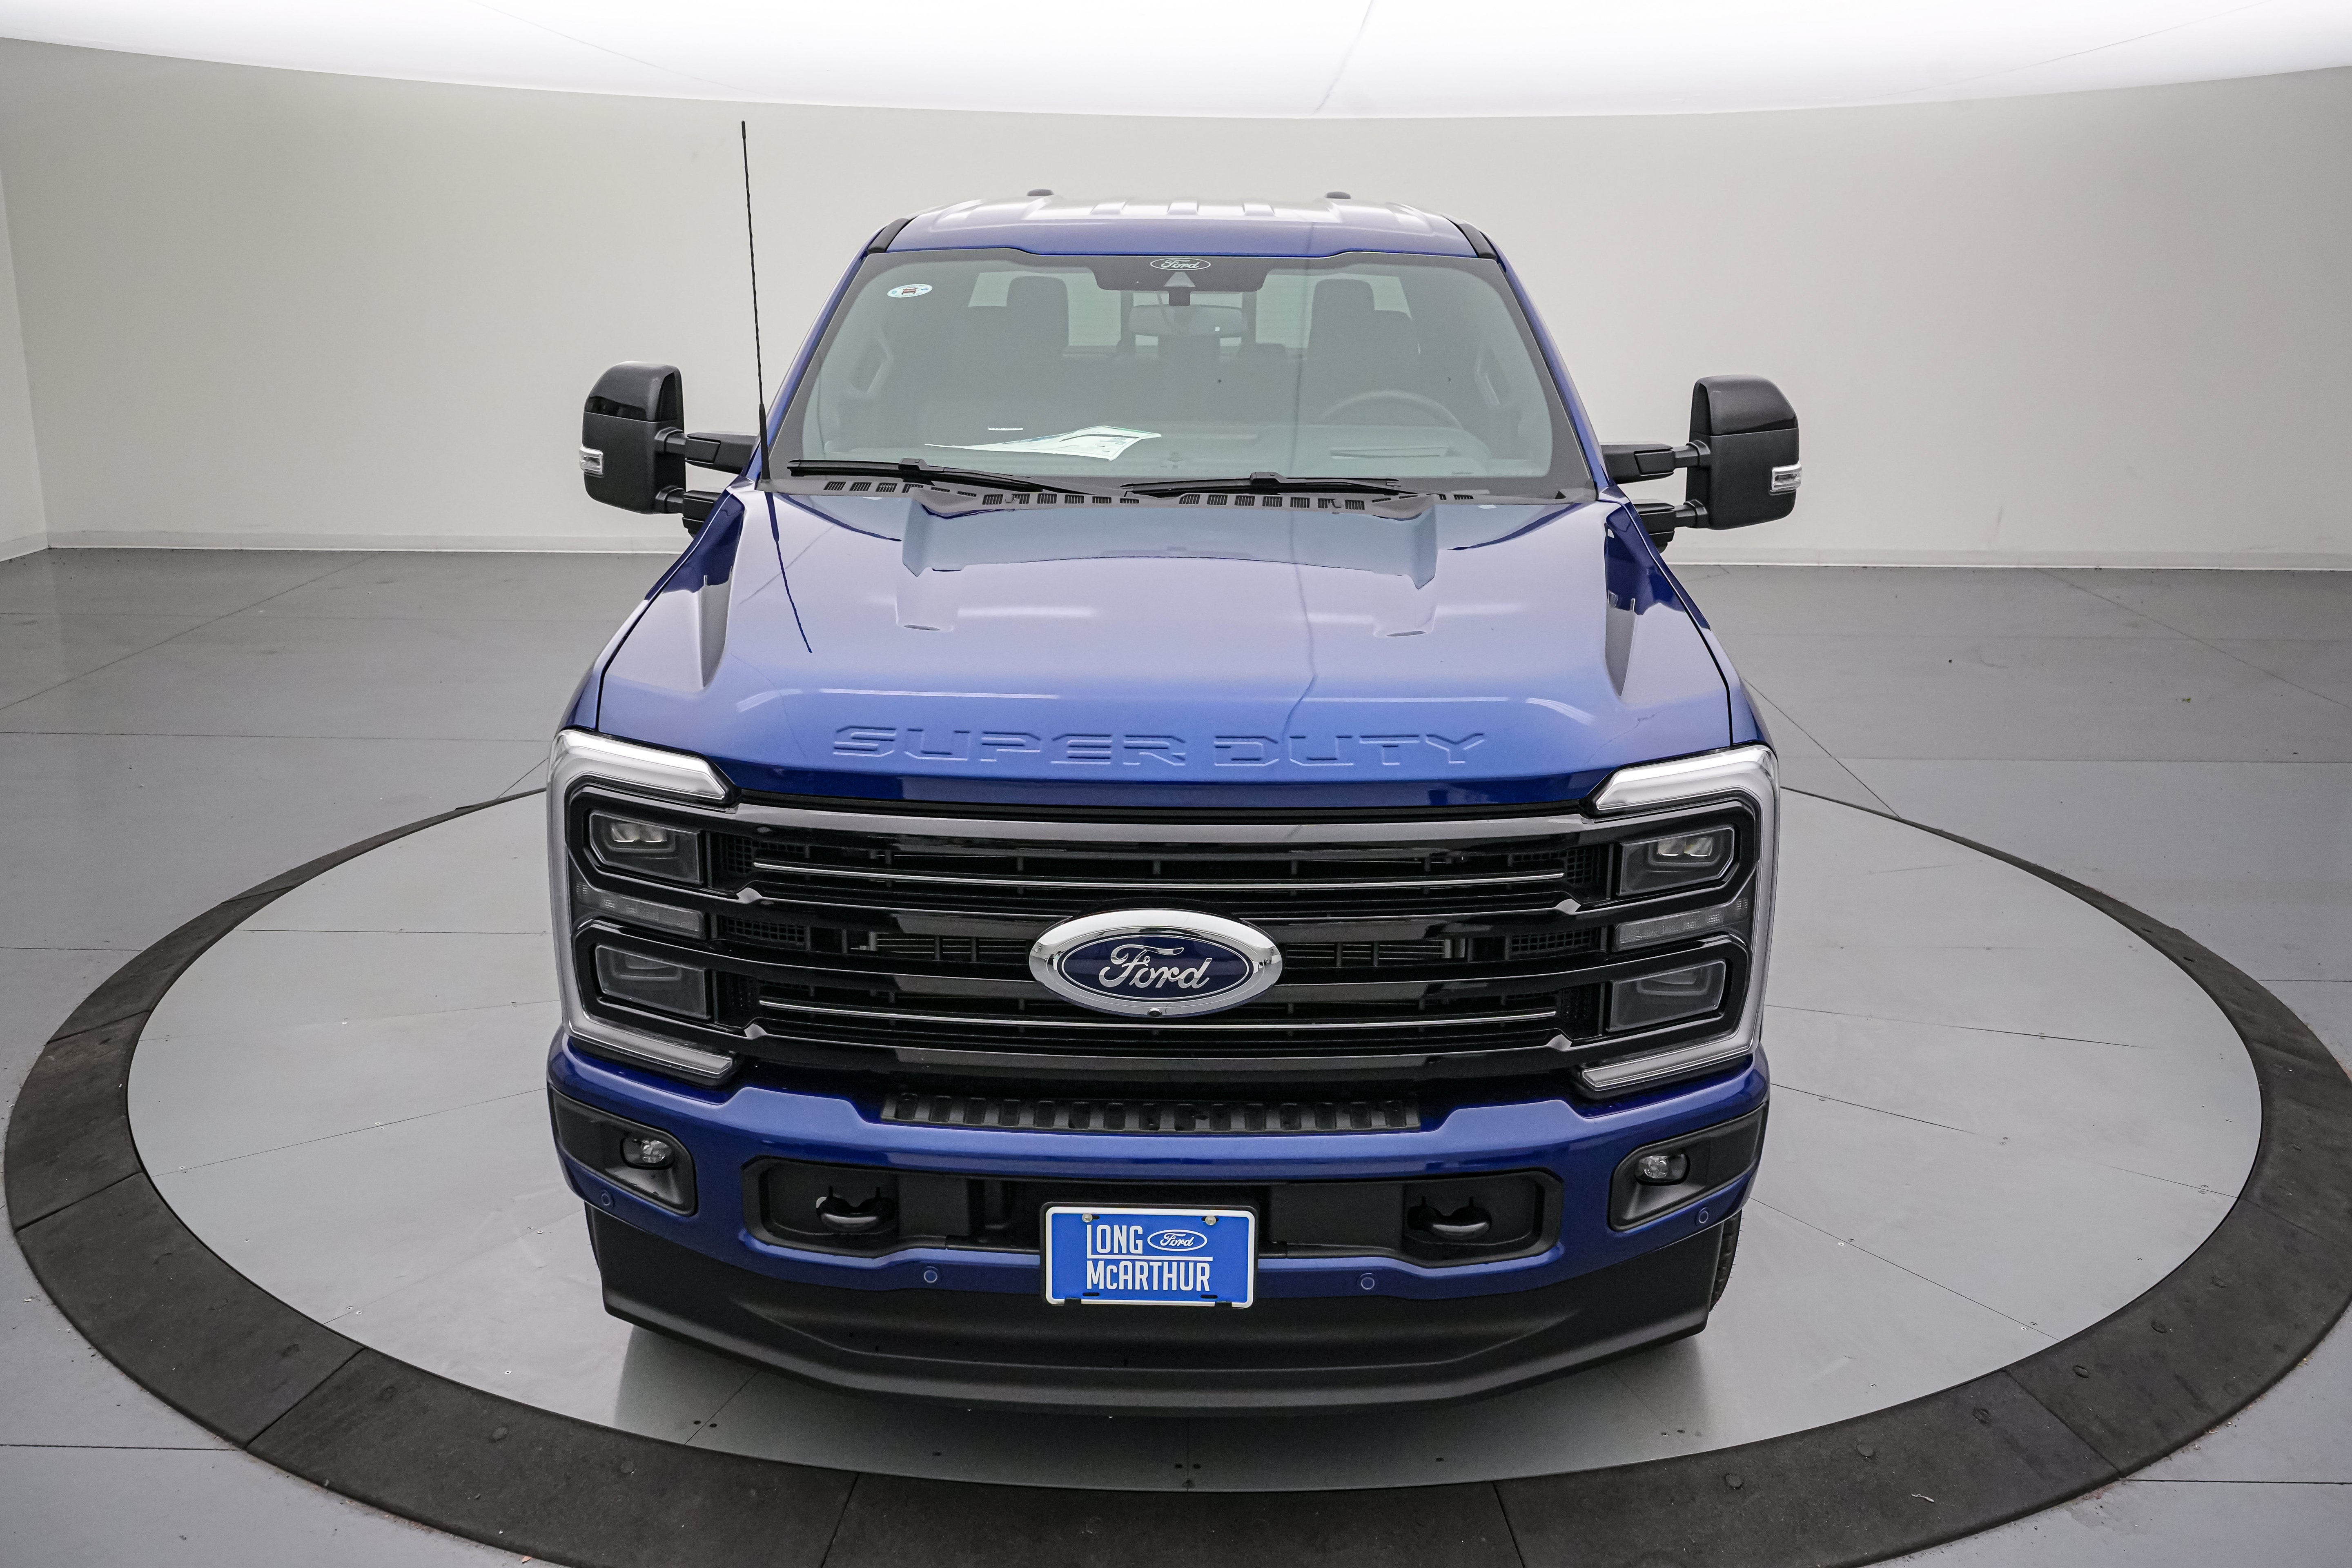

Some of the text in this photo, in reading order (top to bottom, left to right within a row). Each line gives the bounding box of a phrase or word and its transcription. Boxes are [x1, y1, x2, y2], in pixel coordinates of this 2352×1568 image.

[1161, 260, 1199, 268] Ford
[833, 726, 1485, 766] SUPER DUTY
[1099, 944, 1210, 989] Ford
[1087, 1225, 1194, 1256] LONG Ford
[1087, 1260, 1210, 1291] McARTHUR
